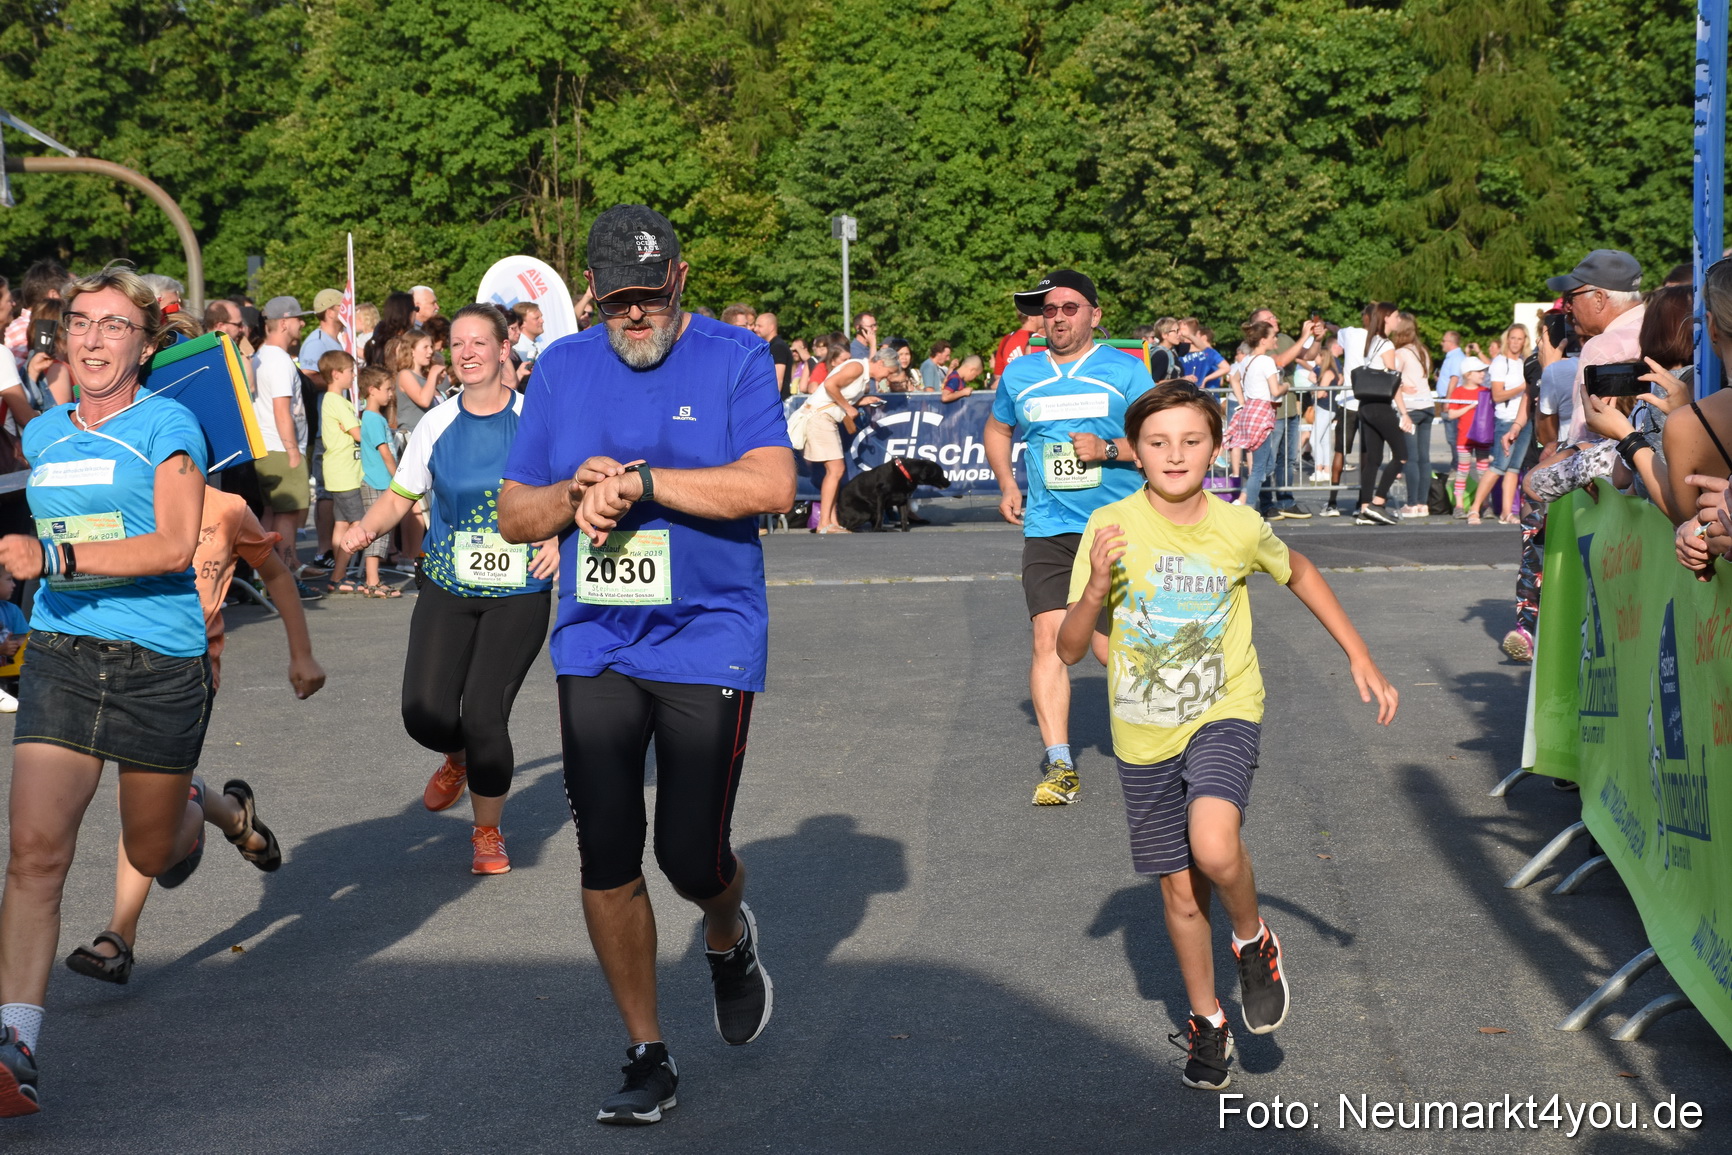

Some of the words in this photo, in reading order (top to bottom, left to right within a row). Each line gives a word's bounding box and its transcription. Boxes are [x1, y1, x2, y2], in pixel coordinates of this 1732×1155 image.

[884, 436, 1028, 465] Fischr
[1053, 459, 1087, 476] 839
[470, 552, 510, 571] 280
[585, 556, 656, 584] 2030
[1155, 555, 1185, 573] JET
[1163, 575, 1229, 594] STREAM
